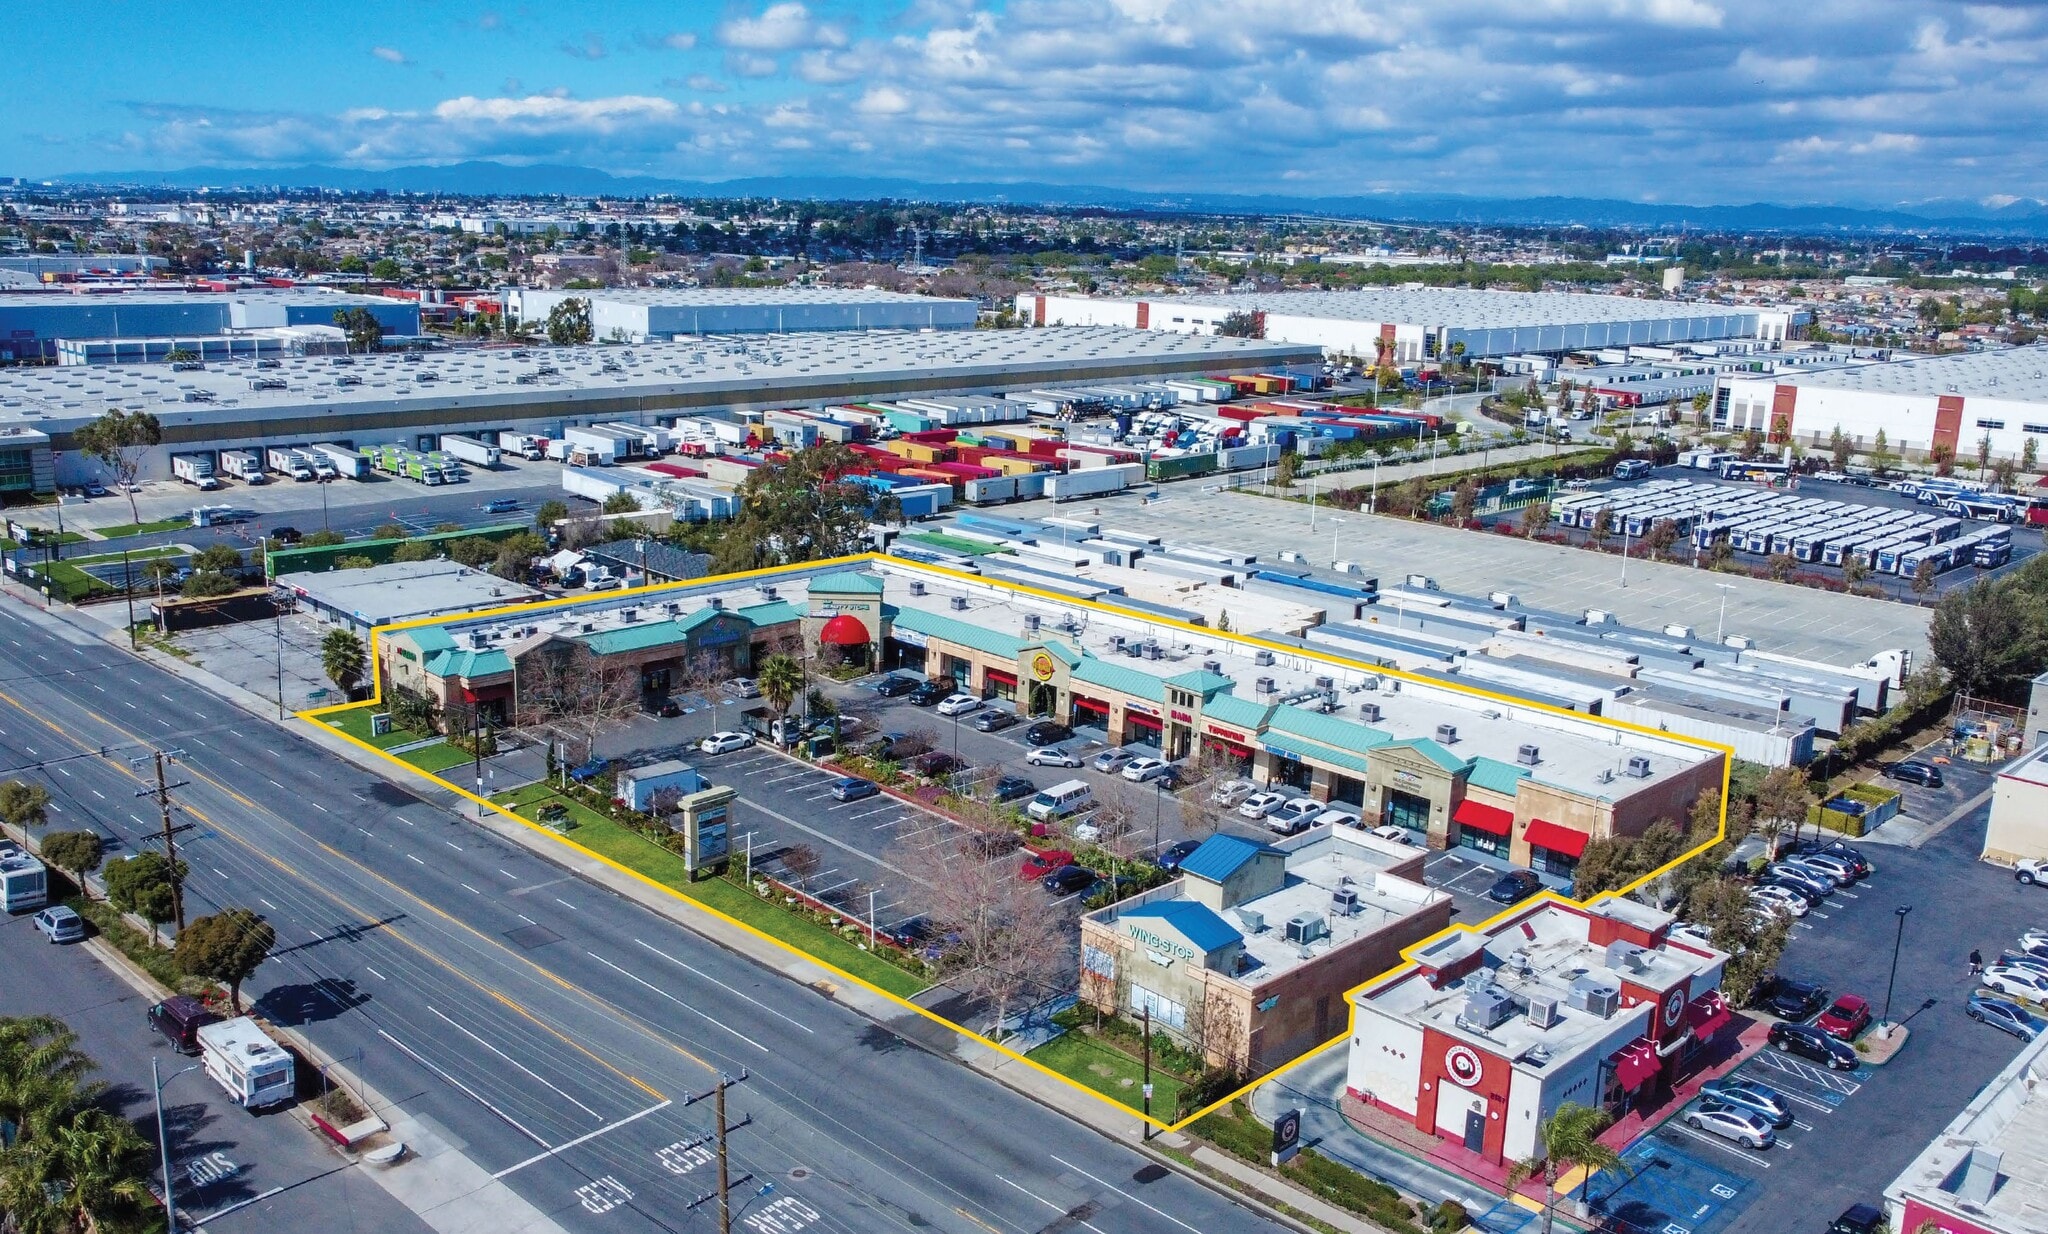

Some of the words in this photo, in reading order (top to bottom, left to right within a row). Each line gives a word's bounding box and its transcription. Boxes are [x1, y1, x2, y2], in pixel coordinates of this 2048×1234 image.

[1903, 484, 1916, 494] LA
[1918, 491, 1932, 500] LA
[1948, 502, 1961, 512] LA
[573, 1175, 635, 1213] KEEP
